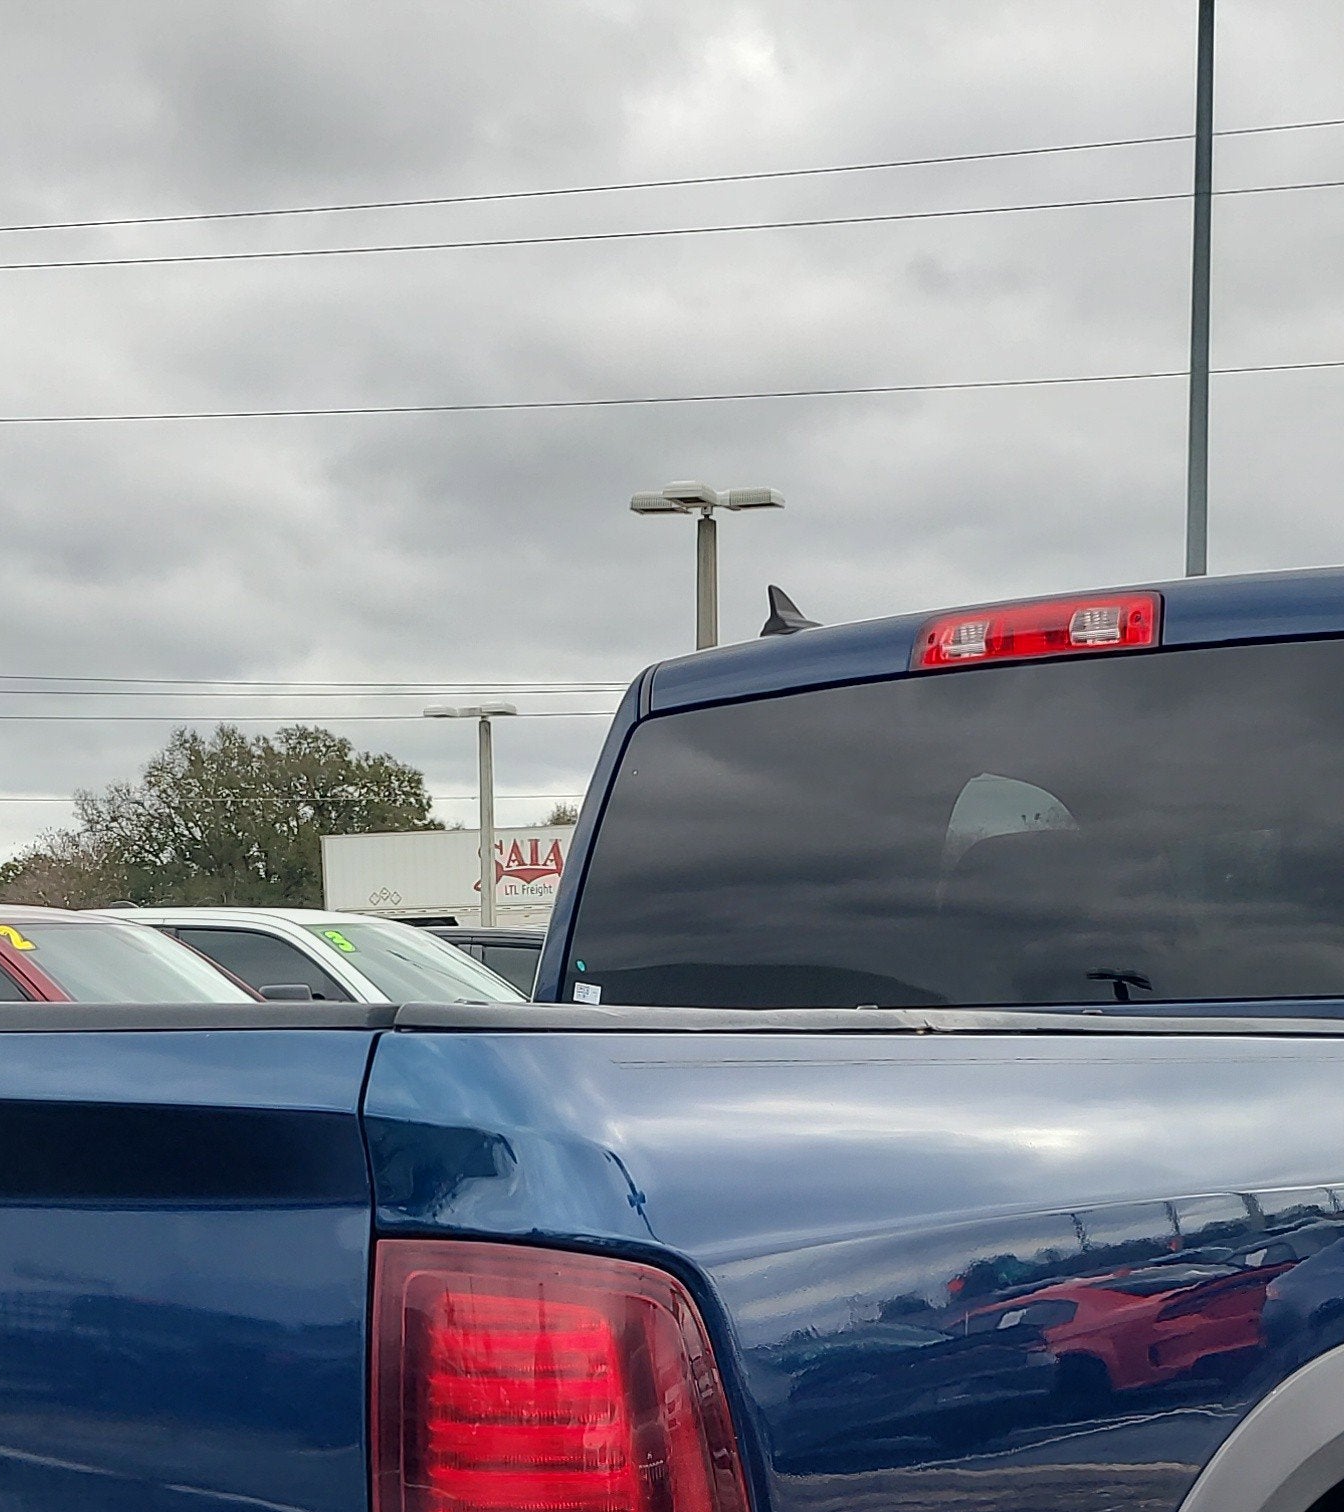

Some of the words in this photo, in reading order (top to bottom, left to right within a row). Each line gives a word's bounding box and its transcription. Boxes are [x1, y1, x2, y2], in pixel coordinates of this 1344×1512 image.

[504, 885, 519, 896] LTL
[521, 883, 553, 897] Freight
[324, 930, 356, 952] 3
